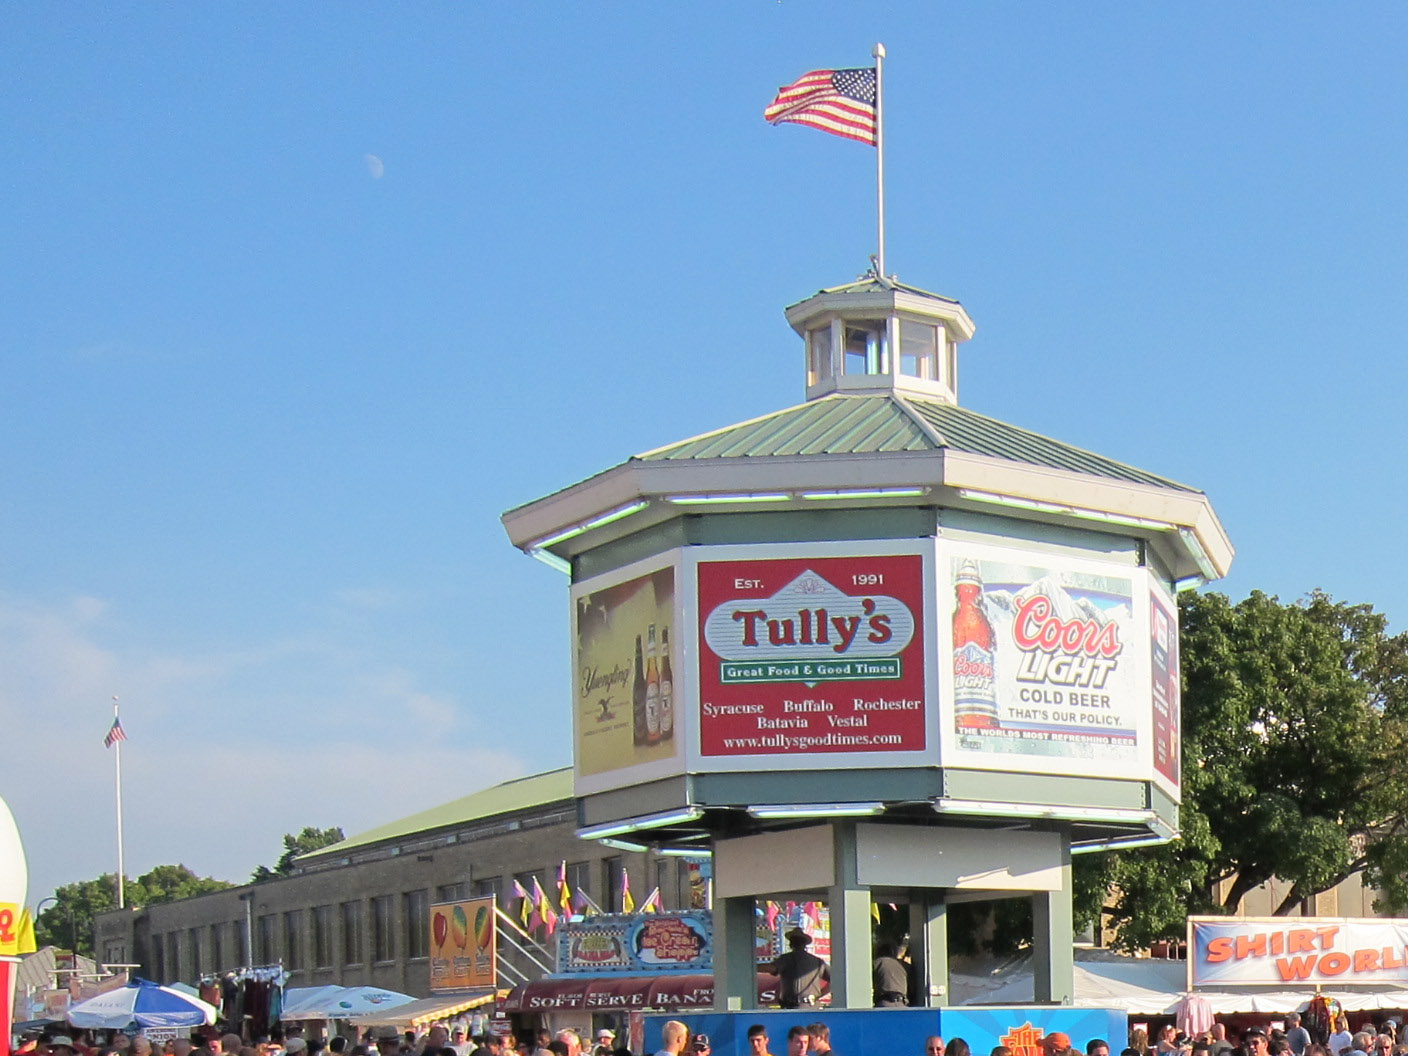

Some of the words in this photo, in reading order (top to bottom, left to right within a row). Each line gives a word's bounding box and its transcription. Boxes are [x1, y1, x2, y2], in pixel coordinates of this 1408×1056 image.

[852, 574, 884, 585] 1991
[732, 598, 893, 653] Tully's
[1012, 594, 1123, 658] Coors
[727, 667, 763, 677] Great
[768, 666, 798, 676] Food
[803, 665, 813, 675] &
[817, 665, 850, 675] Good
[855, 664, 895, 674] Times
[954, 654, 994, 677] Coors
[1016, 651, 1118, 689] LIGHT
[581, 659, 631, 698] Yuengling
[954, 676, 993, 690] LIGHT
[703, 703, 764, 716] Syracuse
[784, 700, 833, 713] Buffalo
[854, 698, 921, 711] Rochester
[1019, 688, 1063, 705] COLD
[1069, 691, 1111, 708] BEER
[757, 716, 808, 729] Batavia
[827, 715, 868, 727] Vestal
[1008, 707, 1049, 721] THAT'S
[1052, 711, 1077, 723] OUR
[1080, 713, 1122, 727] POLICY.
[724, 733, 902, 749] www.tullysgoodtimes.com
[958, 726, 978, 736] THE
[980, 728, 1021, 739] WORLDS
[1023, 730, 1049, 740] MOST
[1051, 732, 1109, 745] REFRESHING
[1111, 736, 1135, 747] BEER
[1206, 926, 1340, 963] SHIRT
[530, 996, 580, 1008] SOFT
[587, 993, 643, 1006] SERVE
